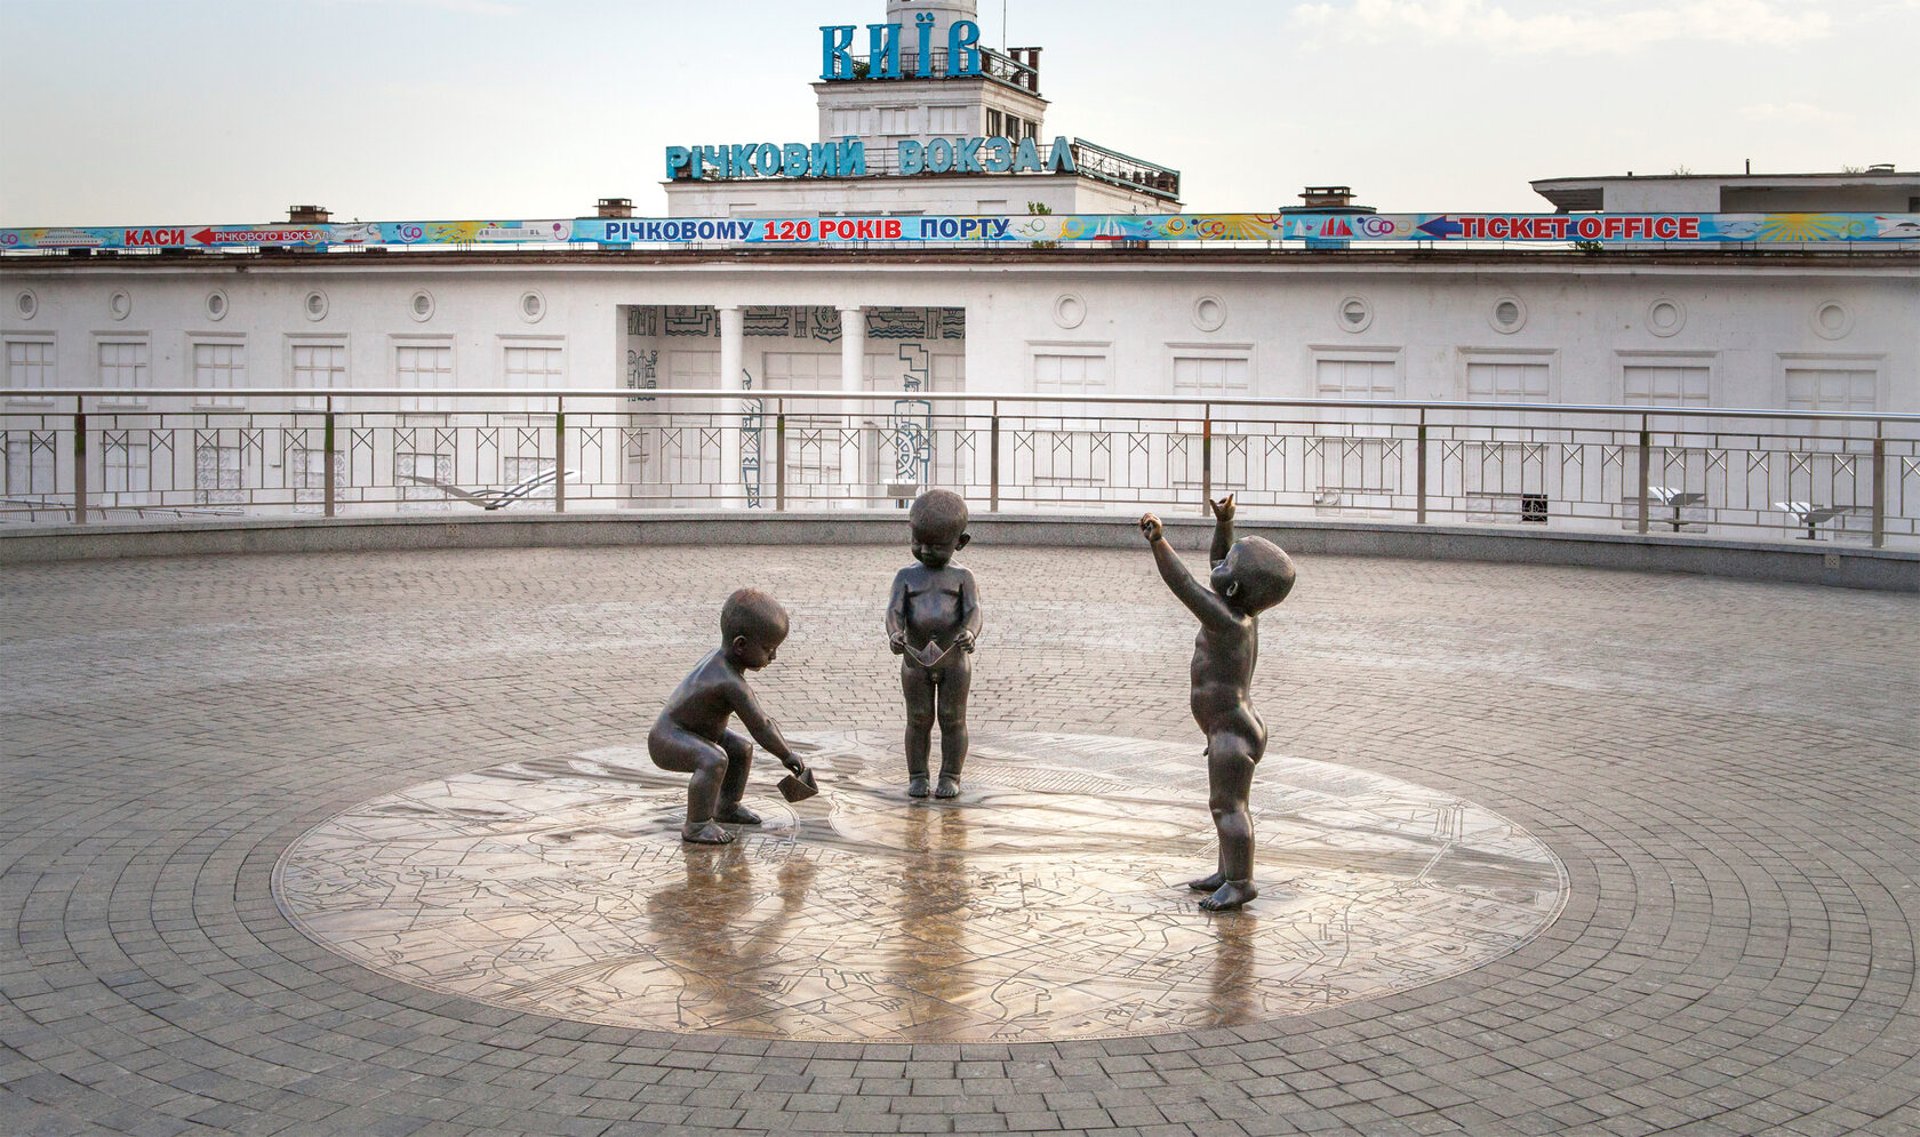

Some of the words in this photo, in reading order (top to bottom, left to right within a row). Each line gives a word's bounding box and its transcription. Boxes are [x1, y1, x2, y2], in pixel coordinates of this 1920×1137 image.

[819, 12, 982, 80] КИЇВ
[666, 136, 866, 180] РІЧКОВИЙ
[898, 136, 1077, 175] ВОКЗАЛ
[125, 229, 186, 246] КАСИ
[215, 231, 278, 242] РІЧКОВОГО
[606, 221, 754, 240] РІЧКОВОМУ
[764, 220, 811, 240] 120
[819, 220, 902, 239] РОКІВ
[920, 218, 1009, 238] ПОРТУ
[1459, 217, 1571, 239] TICKET
[1578, 217, 1700, 239] OFFICE
